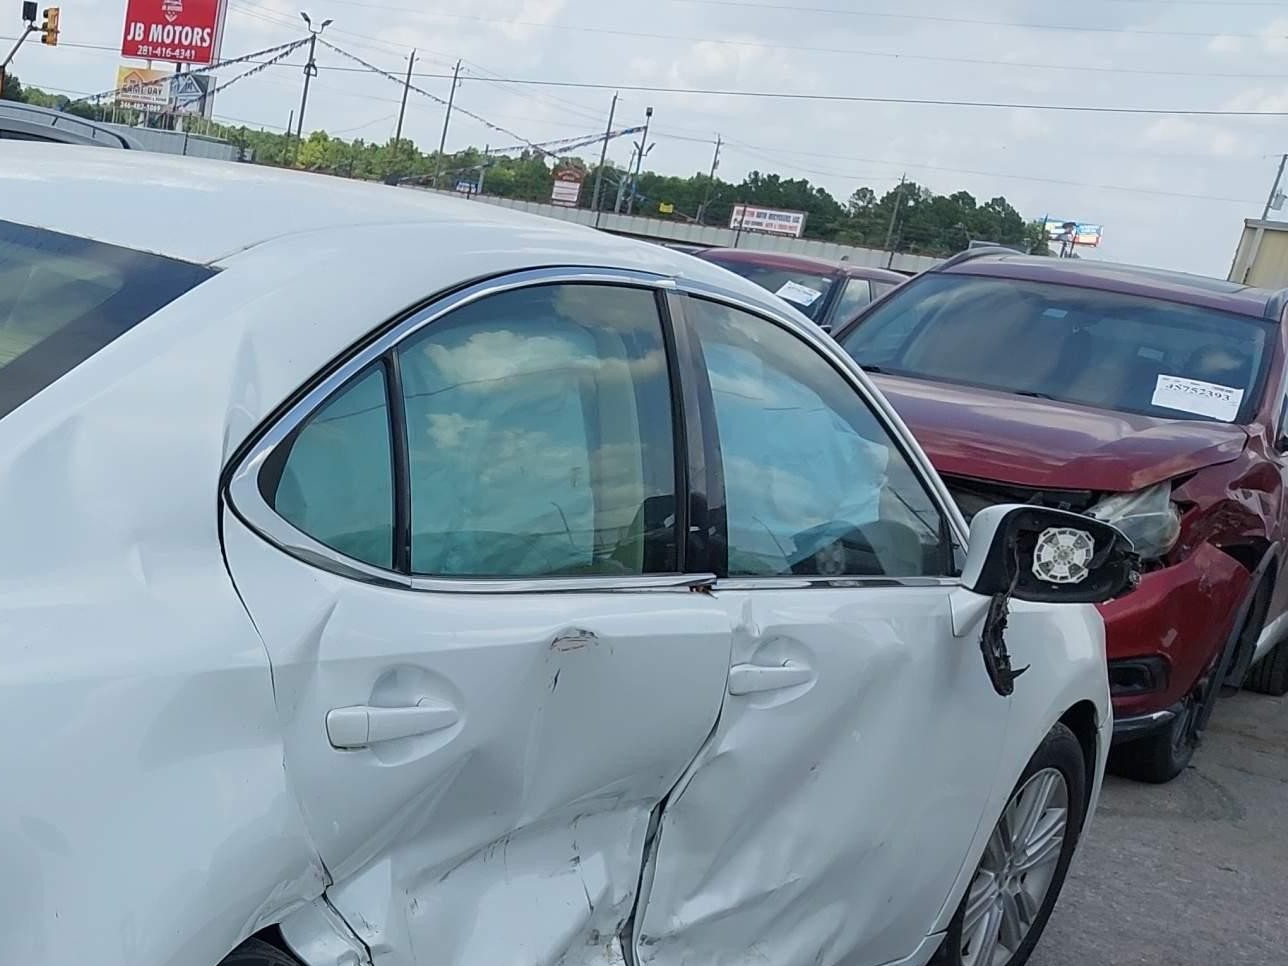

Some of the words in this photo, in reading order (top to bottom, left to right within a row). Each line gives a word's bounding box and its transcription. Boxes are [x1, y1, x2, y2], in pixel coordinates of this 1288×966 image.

[127, 22, 144, 42] JB
[149, 24, 211, 47] MOTORS
[137, 45, 195, 59] 281-416-4341
[147, 86, 162, 96] DAY
